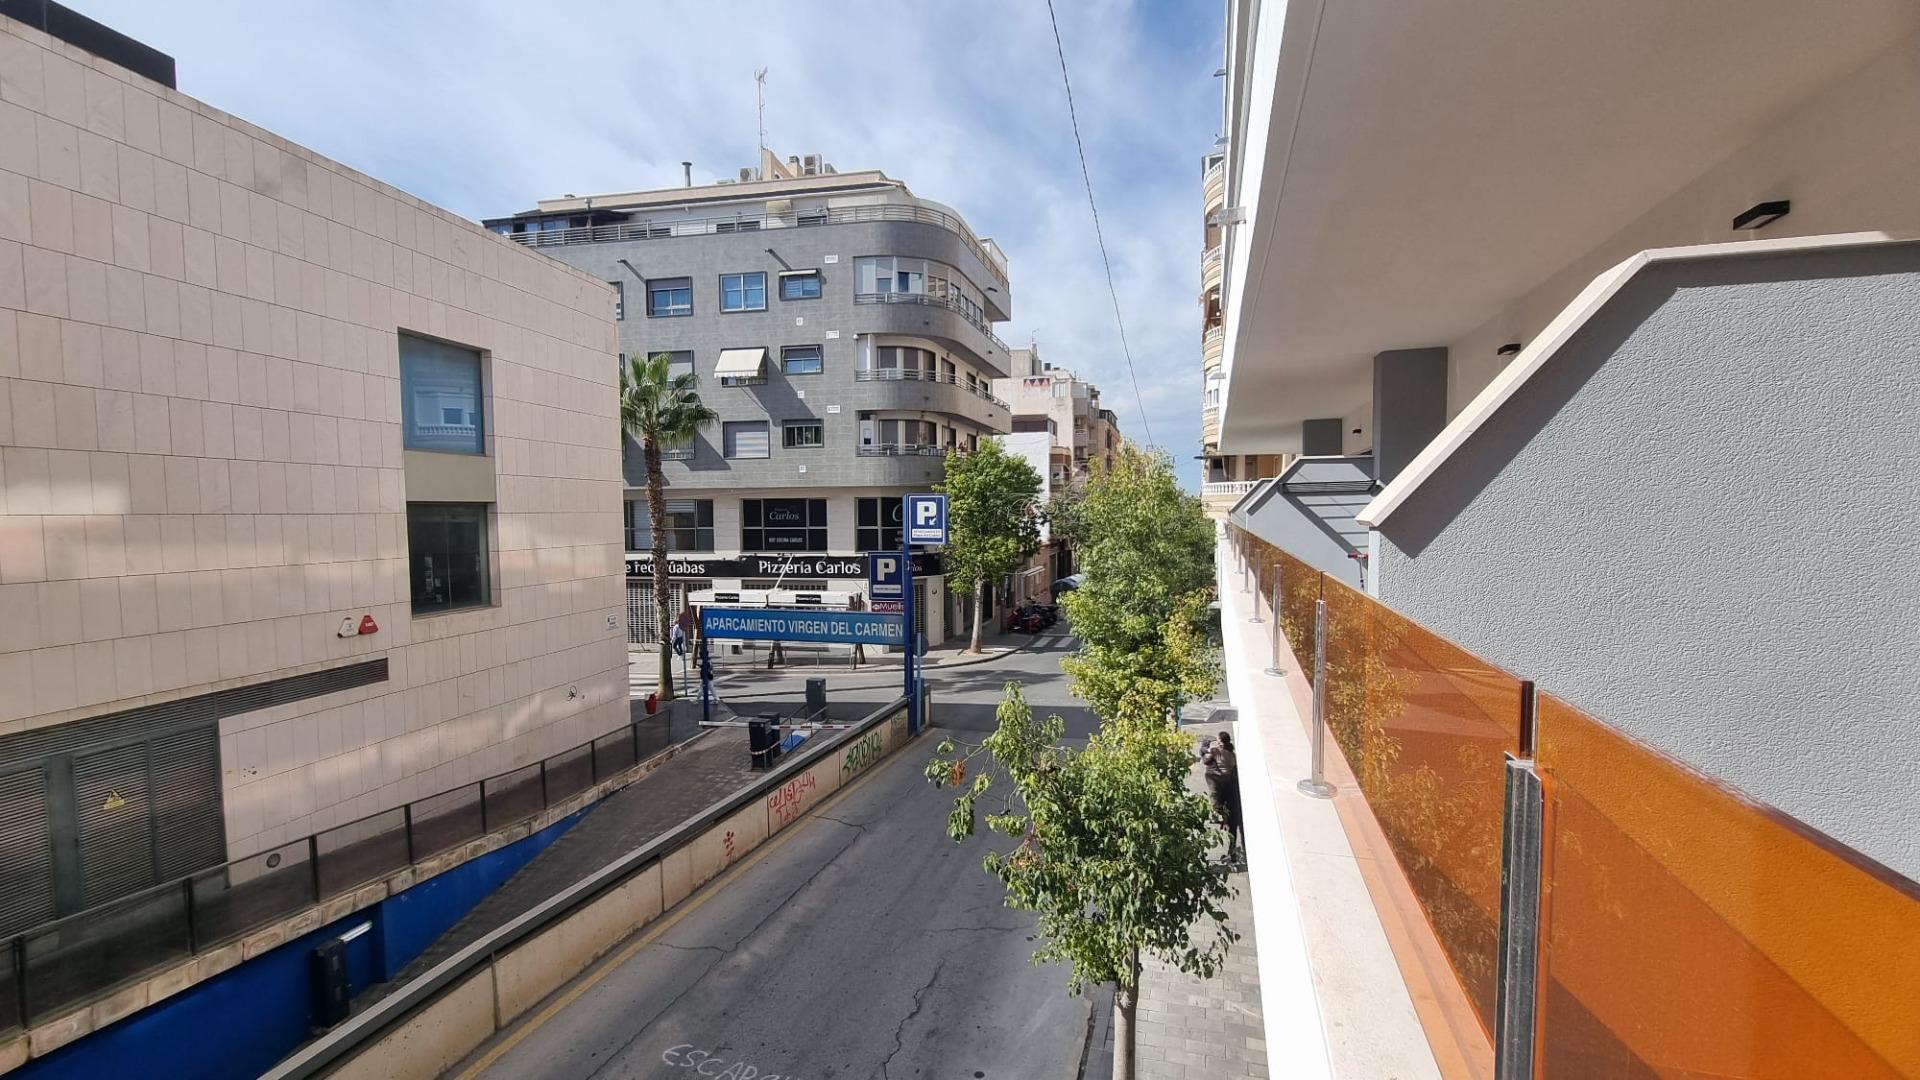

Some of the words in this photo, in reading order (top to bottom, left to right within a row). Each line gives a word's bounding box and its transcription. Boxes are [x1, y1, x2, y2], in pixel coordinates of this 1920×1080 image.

[769, 511, 800, 520] Carlos
[916, 501, 937, 526] P
[815, 560, 861, 574] Carlos
[876, 558, 897, 582] P
[705, 617, 786, 633] APARCAMIENTO
[788, 619, 828, 635] VIRGEN
[831, 621, 852, 636] DEL
[855, 622, 904, 638] CARMEN
